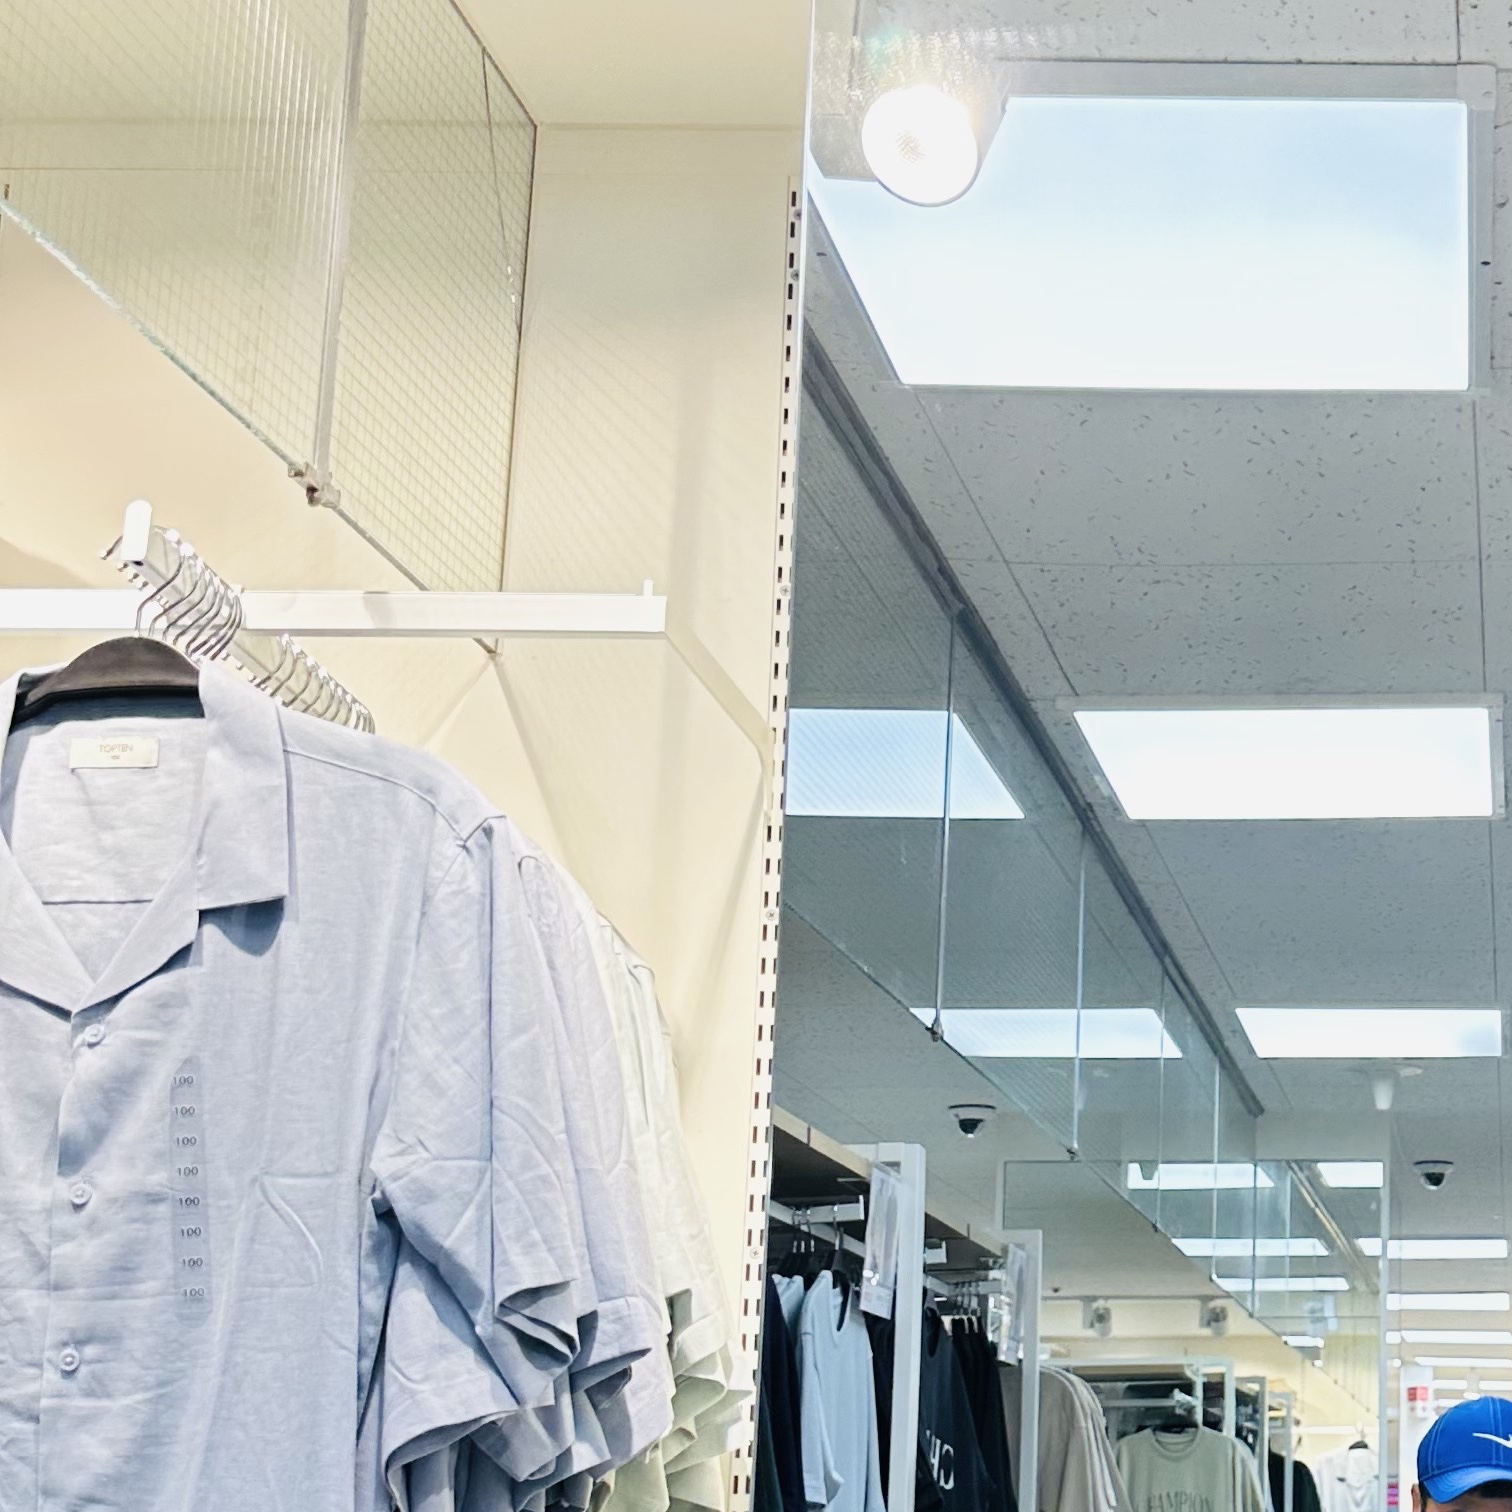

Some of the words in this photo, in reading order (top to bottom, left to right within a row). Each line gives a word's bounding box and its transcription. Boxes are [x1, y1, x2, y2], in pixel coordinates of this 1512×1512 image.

[98, 743, 134, 753] TOPTEN
[172, 1076, 194, 1086] 100
[174, 1106, 196, 1116] 100
[175, 1136, 197, 1146] 100
[176, 1167, 199, 1177] 100
[178, 1197, 200, 1207] 100
[180, 1227, 202, 1237] 100
[181, 1258, 203, 1268] 100
[183, 1287, 205, 1297] 100
